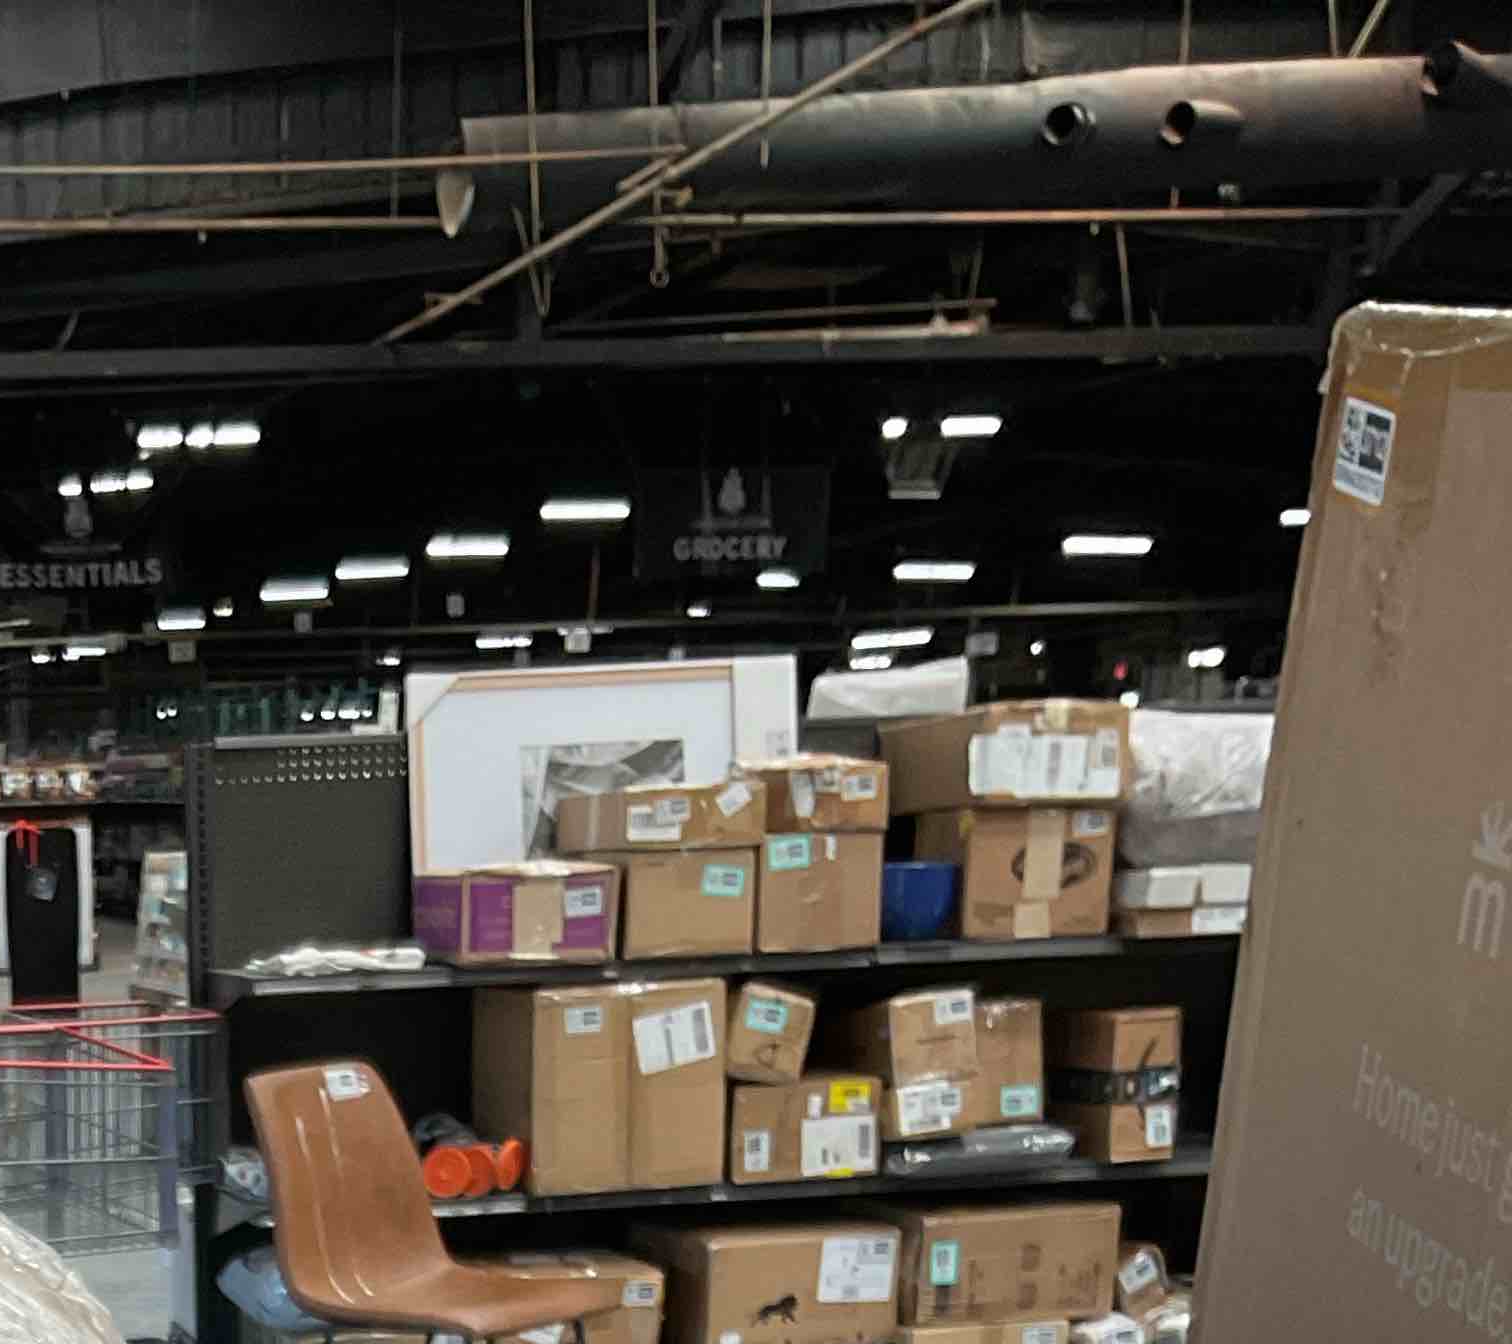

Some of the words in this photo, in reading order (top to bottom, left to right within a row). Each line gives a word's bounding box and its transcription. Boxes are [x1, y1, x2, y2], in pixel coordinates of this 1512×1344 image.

[673, 536, 787, 561] GROCERY
[1353, 1043, 1439, 1154] Home
[1434, 1096, 1501, 1193] just
[1346, 1185, 1383, 1253] an
